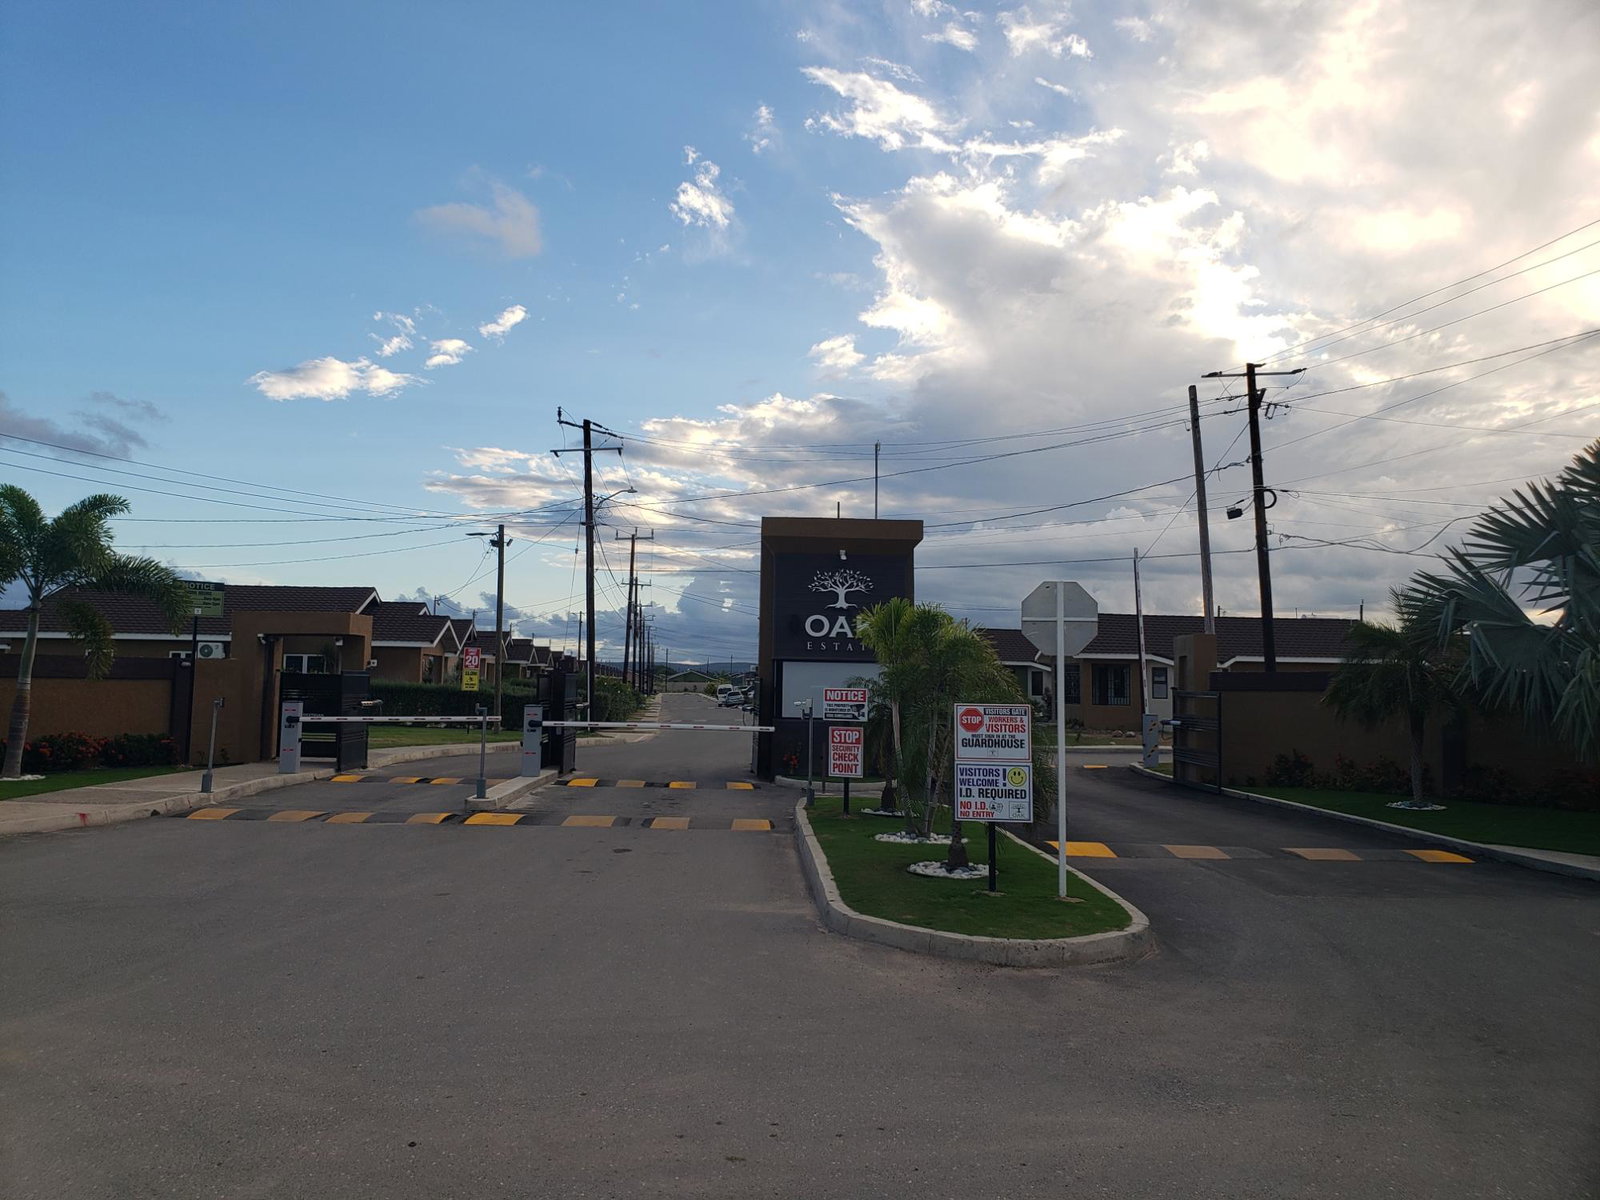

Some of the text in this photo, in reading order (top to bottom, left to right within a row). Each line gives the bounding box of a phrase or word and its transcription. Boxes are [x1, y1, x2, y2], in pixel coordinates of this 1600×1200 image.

[807, 641, 866, 651] ESTAT
[466, 655, 478, 665] 20
[826, 691, 864, 701] NOTICE
[962, 716, 982, 724] STOP
[985, 724, 1026, 733] VISITORS
[833, 730, 860, 743] STOP
[962, 738, 1026, 748] GUARDHOUSE
[832, 752, 859, 762] CHECK
[832, 763, 859, 774] POINT
[959, 768, 1000, 778] VISITORS
[960, 778, 1000, 787] WELCOME
[960, 788, 1026, 800] I.D. REQUIRED
[960, 801, 988, 810] NO I.D.
